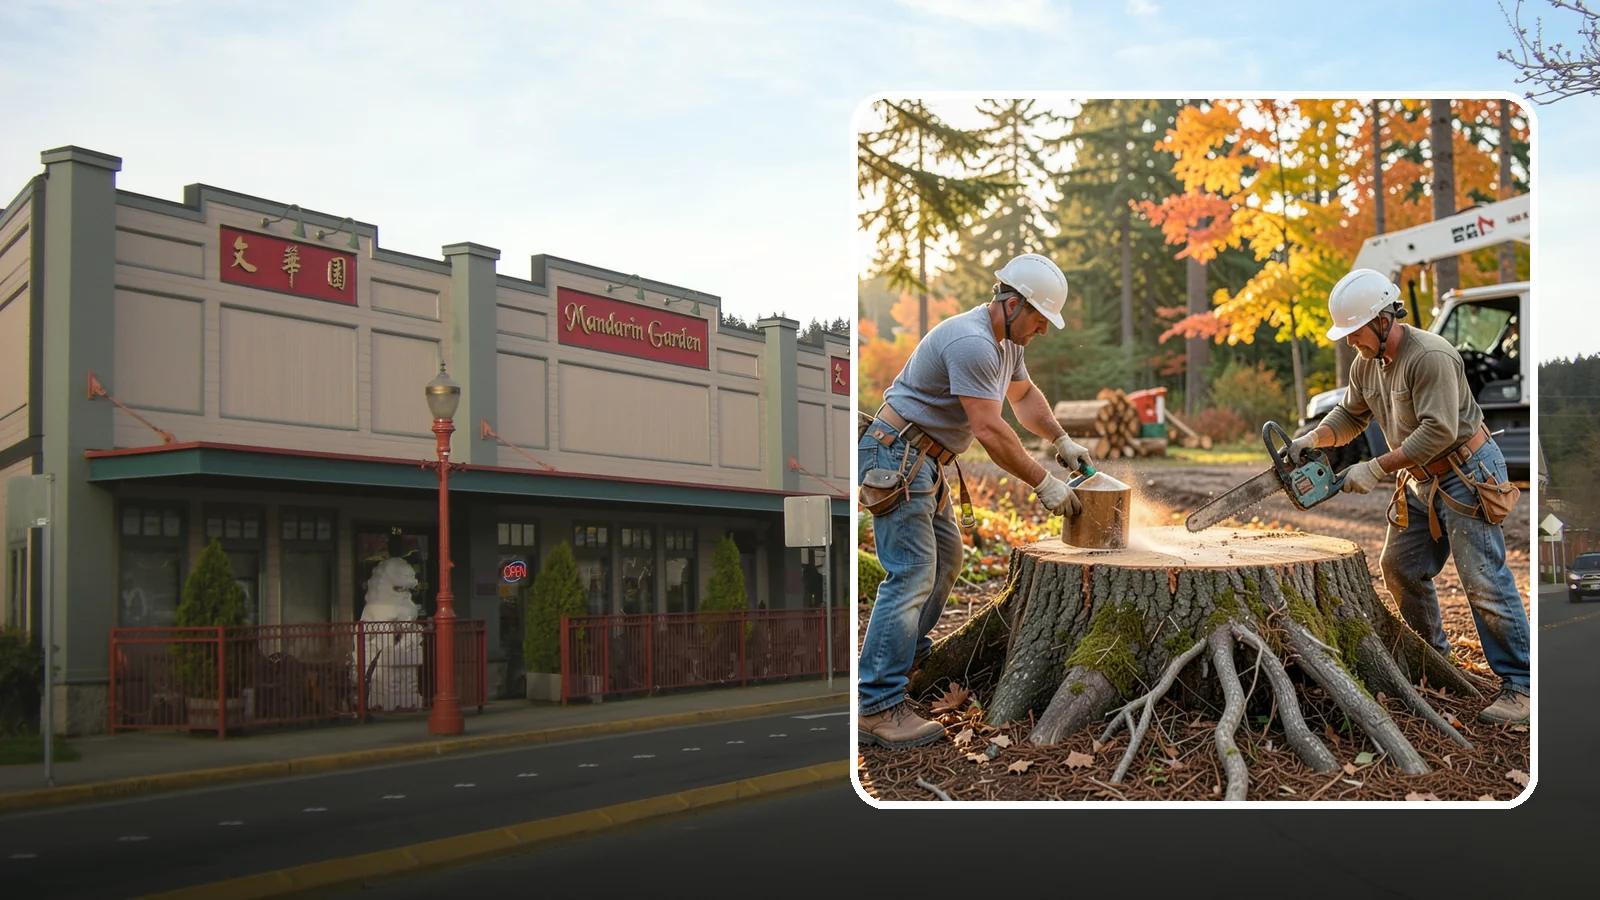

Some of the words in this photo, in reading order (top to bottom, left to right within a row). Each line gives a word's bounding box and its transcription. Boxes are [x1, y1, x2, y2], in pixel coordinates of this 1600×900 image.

[564, 302, 644, 341] Mandarin
[648, 320, 702, 352] Garden
[503, 565, 526, 578] OPEN
